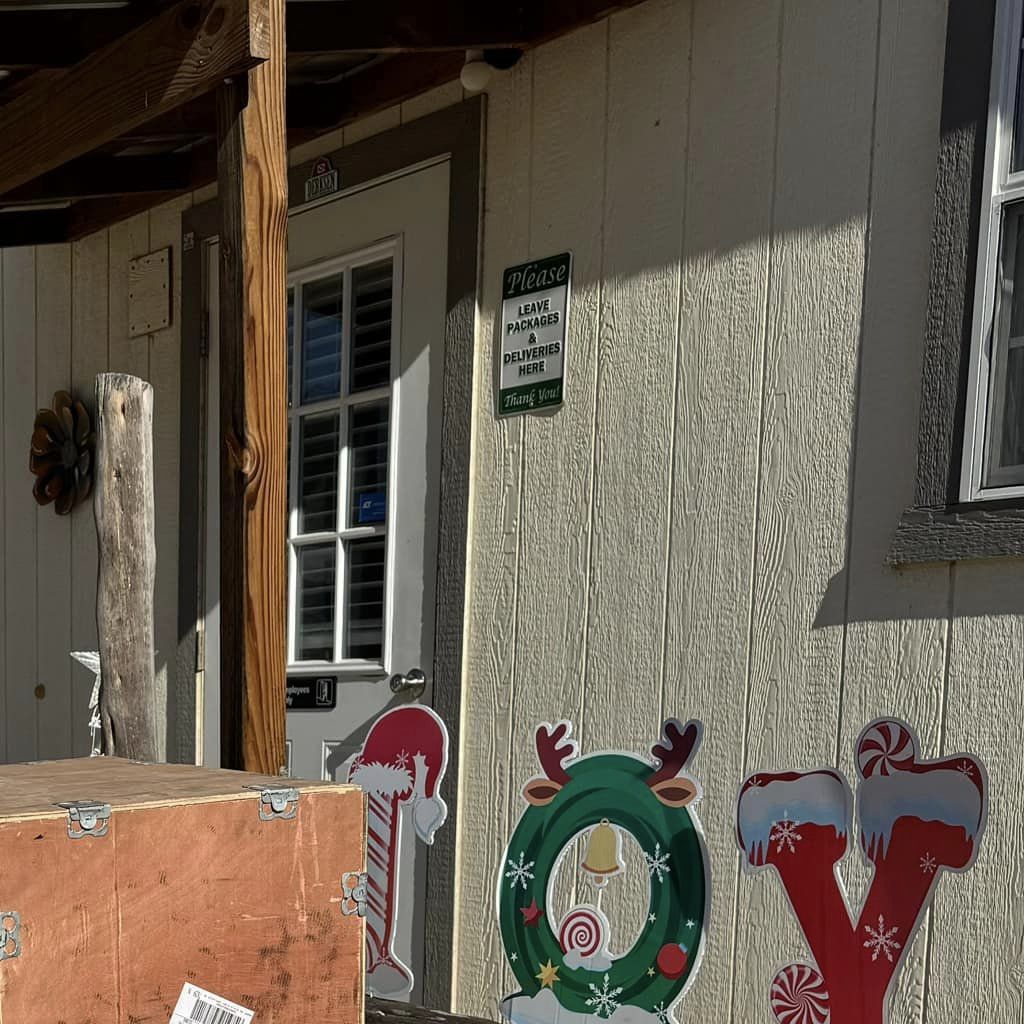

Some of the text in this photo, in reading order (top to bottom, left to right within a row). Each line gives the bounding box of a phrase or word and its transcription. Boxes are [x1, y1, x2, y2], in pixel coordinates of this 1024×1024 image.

[508, 263, 566, 294] Please
[519, 299, 550, 316] LEAVE
[507, 312, 560, 334] PACKAGES
[528, 333, 537, 344] &
[504, 342, 561, 364] DELIVERIES
[518, 361, 545, 377] HERE
[504, 389, 536, 407] Thank
